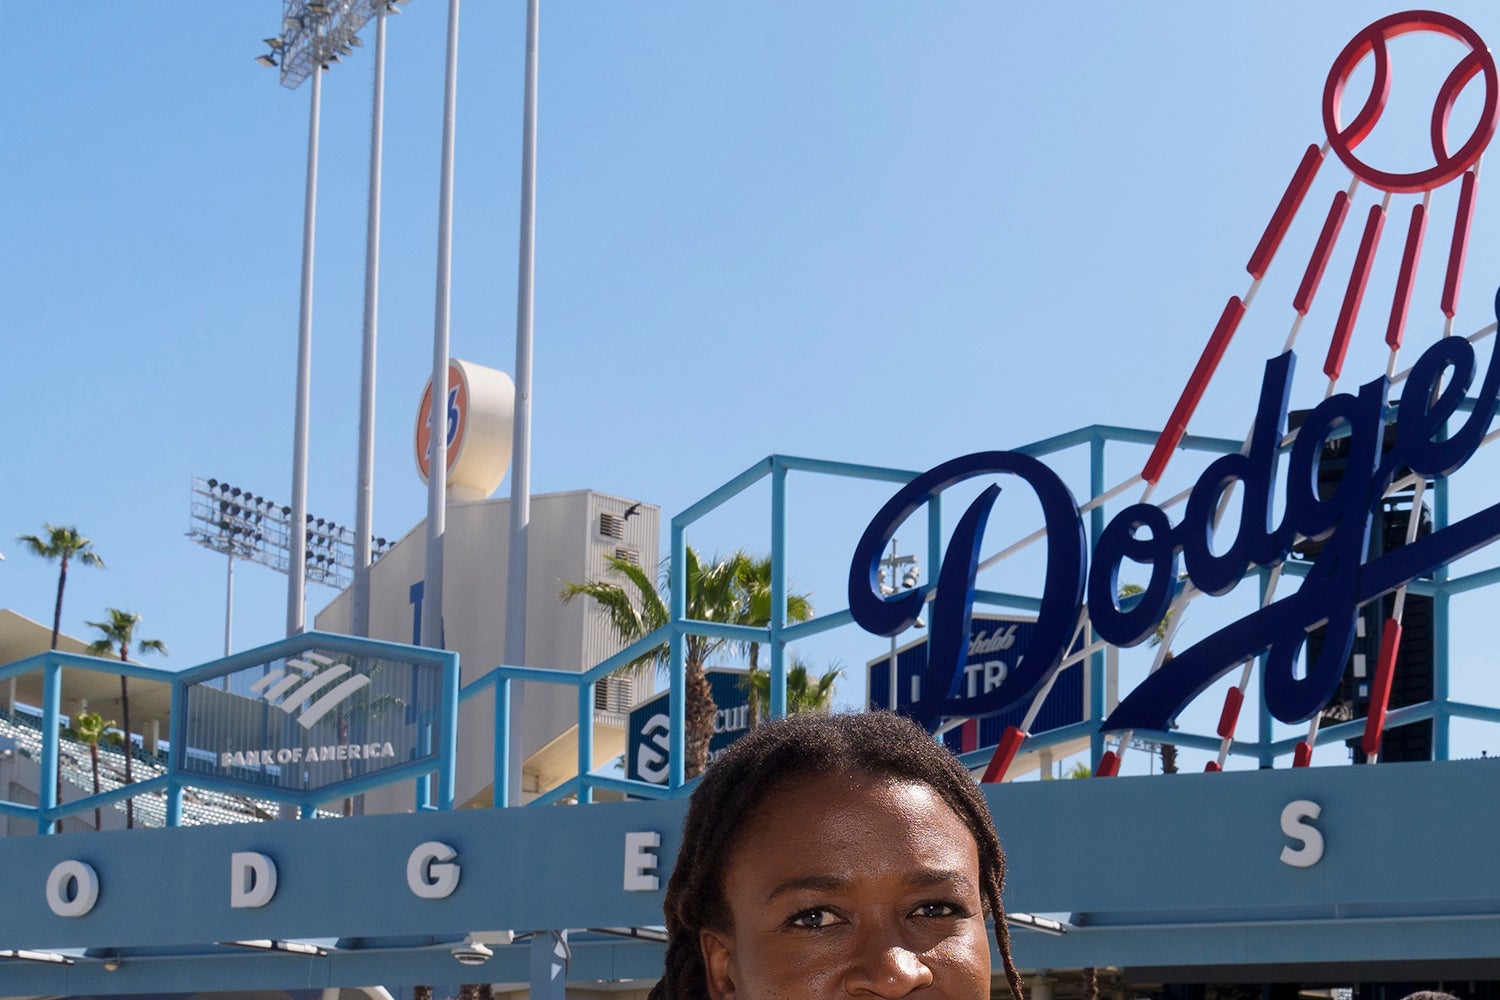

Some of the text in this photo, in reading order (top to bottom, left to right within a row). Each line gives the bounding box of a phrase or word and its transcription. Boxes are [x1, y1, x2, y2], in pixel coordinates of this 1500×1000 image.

[221, 742, 394, 768] BANK OF AMERICA
